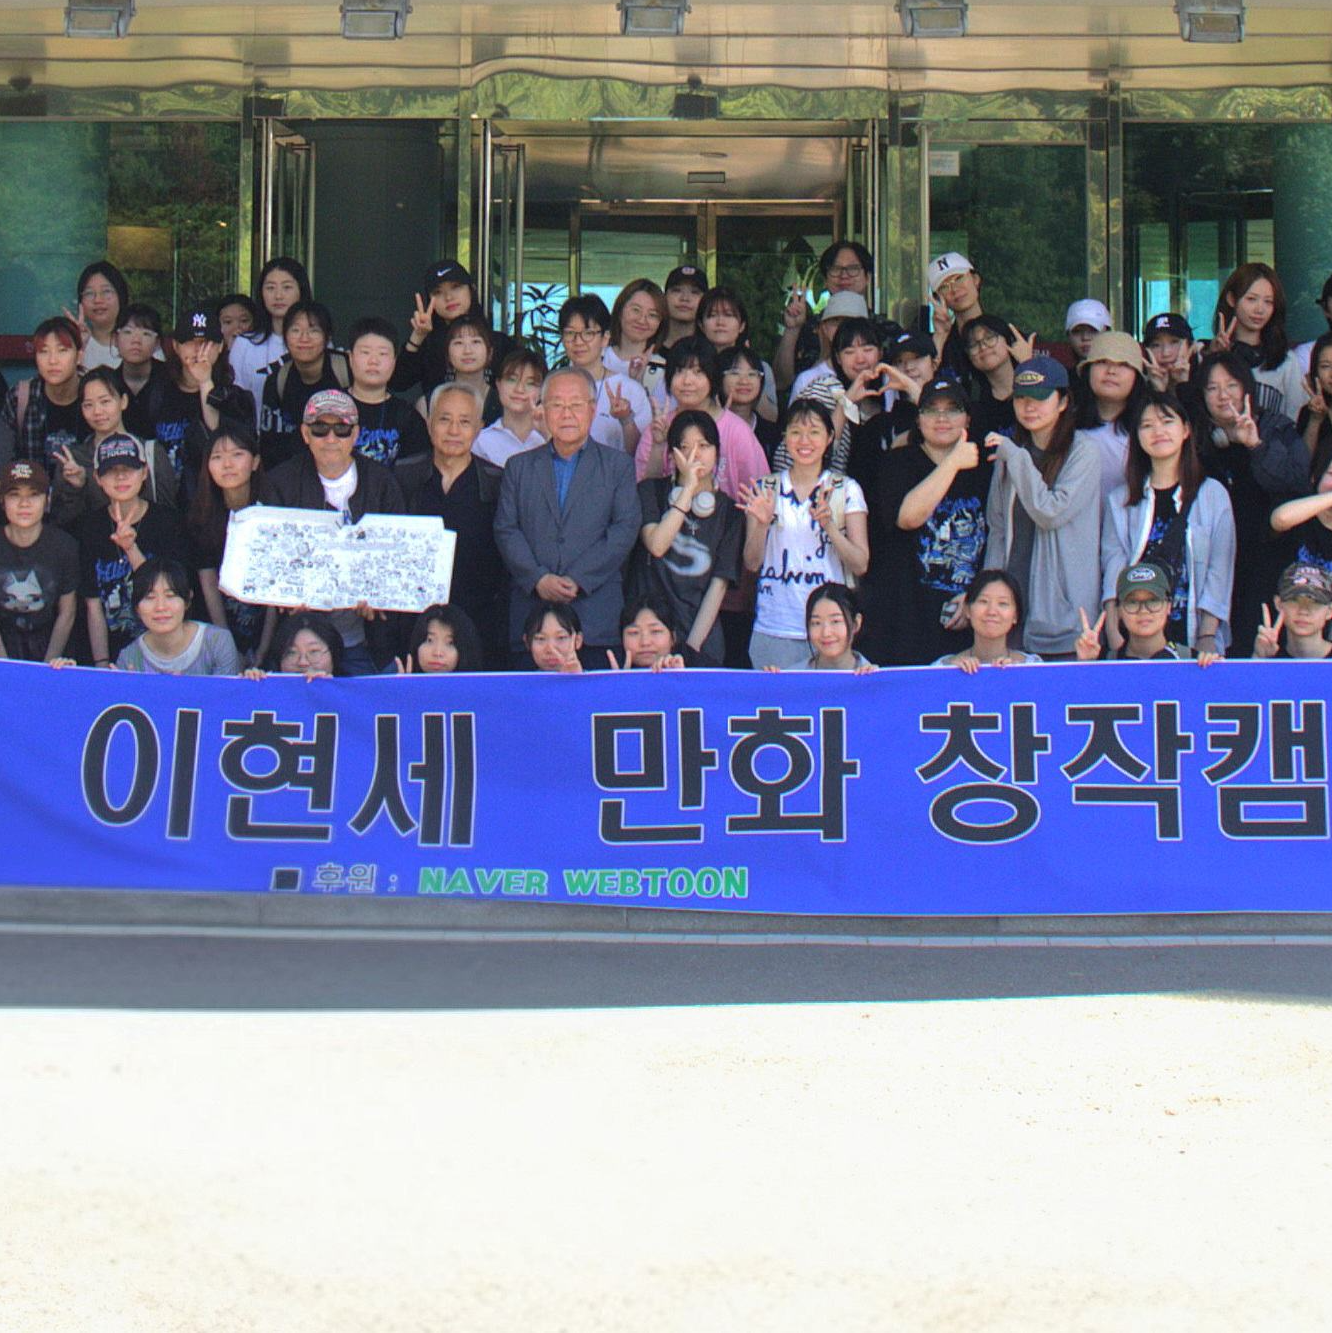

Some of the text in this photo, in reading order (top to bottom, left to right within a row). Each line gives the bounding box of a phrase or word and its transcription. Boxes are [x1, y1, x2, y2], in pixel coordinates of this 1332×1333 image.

[81, 701, 476, 850] 이현세
[590, 706, 861, 847] 만화
[311, 863, 379, 895] 후원
[417, 867, 549, 897] NAVER
[562, 867, 750, 900] WEBTOON
